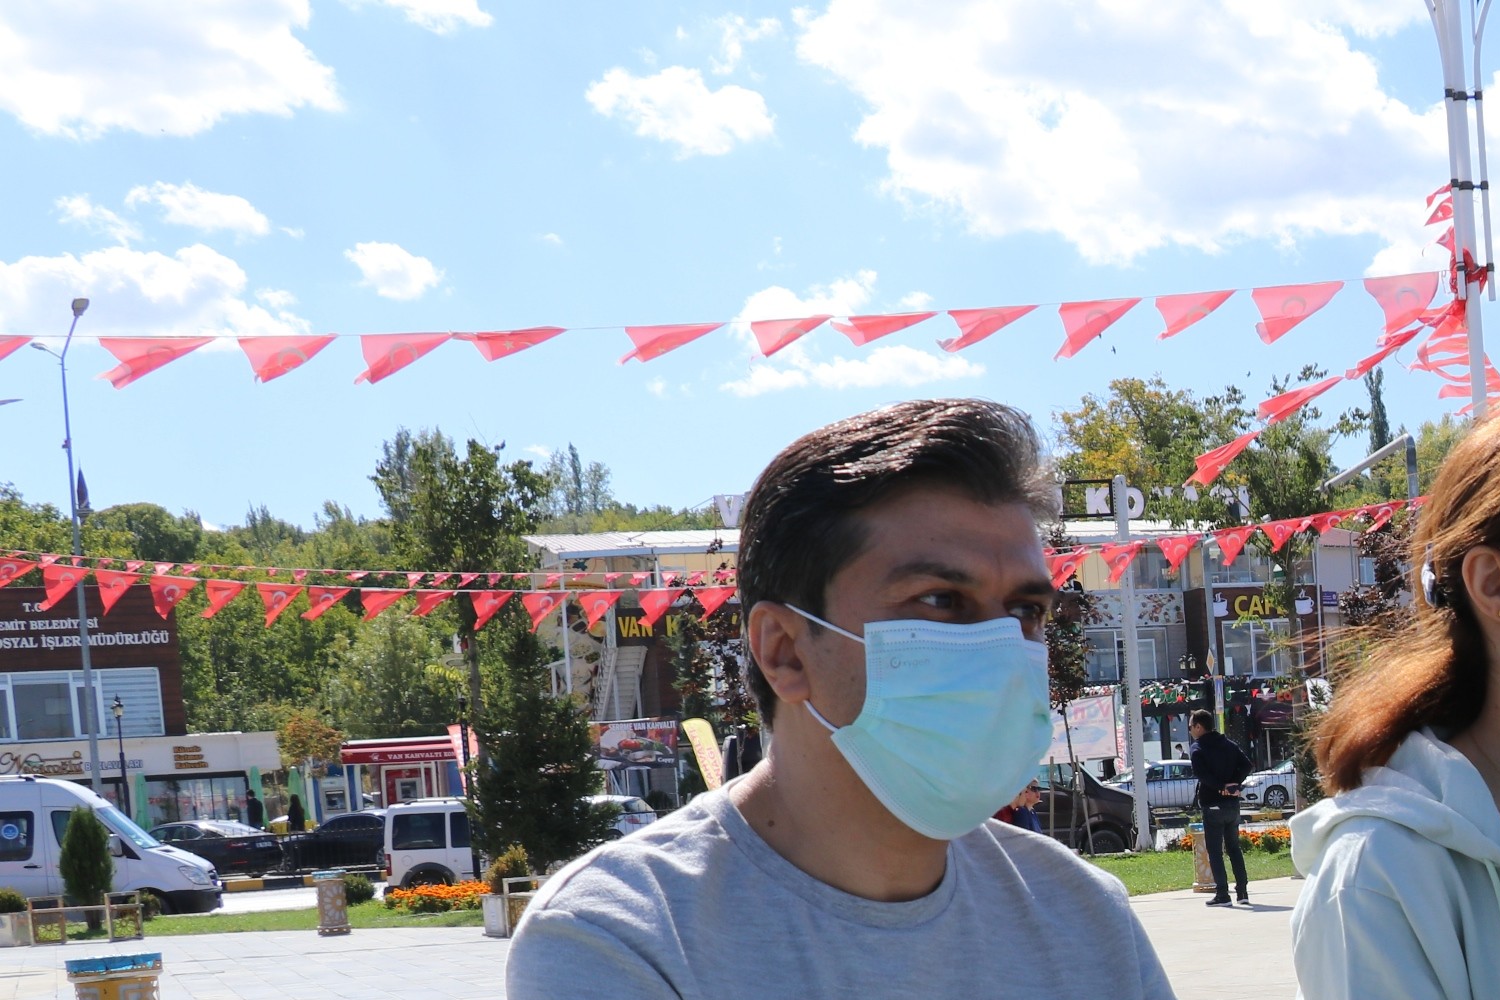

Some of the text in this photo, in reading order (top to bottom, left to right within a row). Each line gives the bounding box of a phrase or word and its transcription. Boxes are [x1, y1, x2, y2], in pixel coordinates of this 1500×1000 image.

[29, 616, 99, 630] BELEDİYSİ
[0, 637, 38, 649] SYAL
[87, 630, 169, 646] MÜDÜRLÜĞÜ
